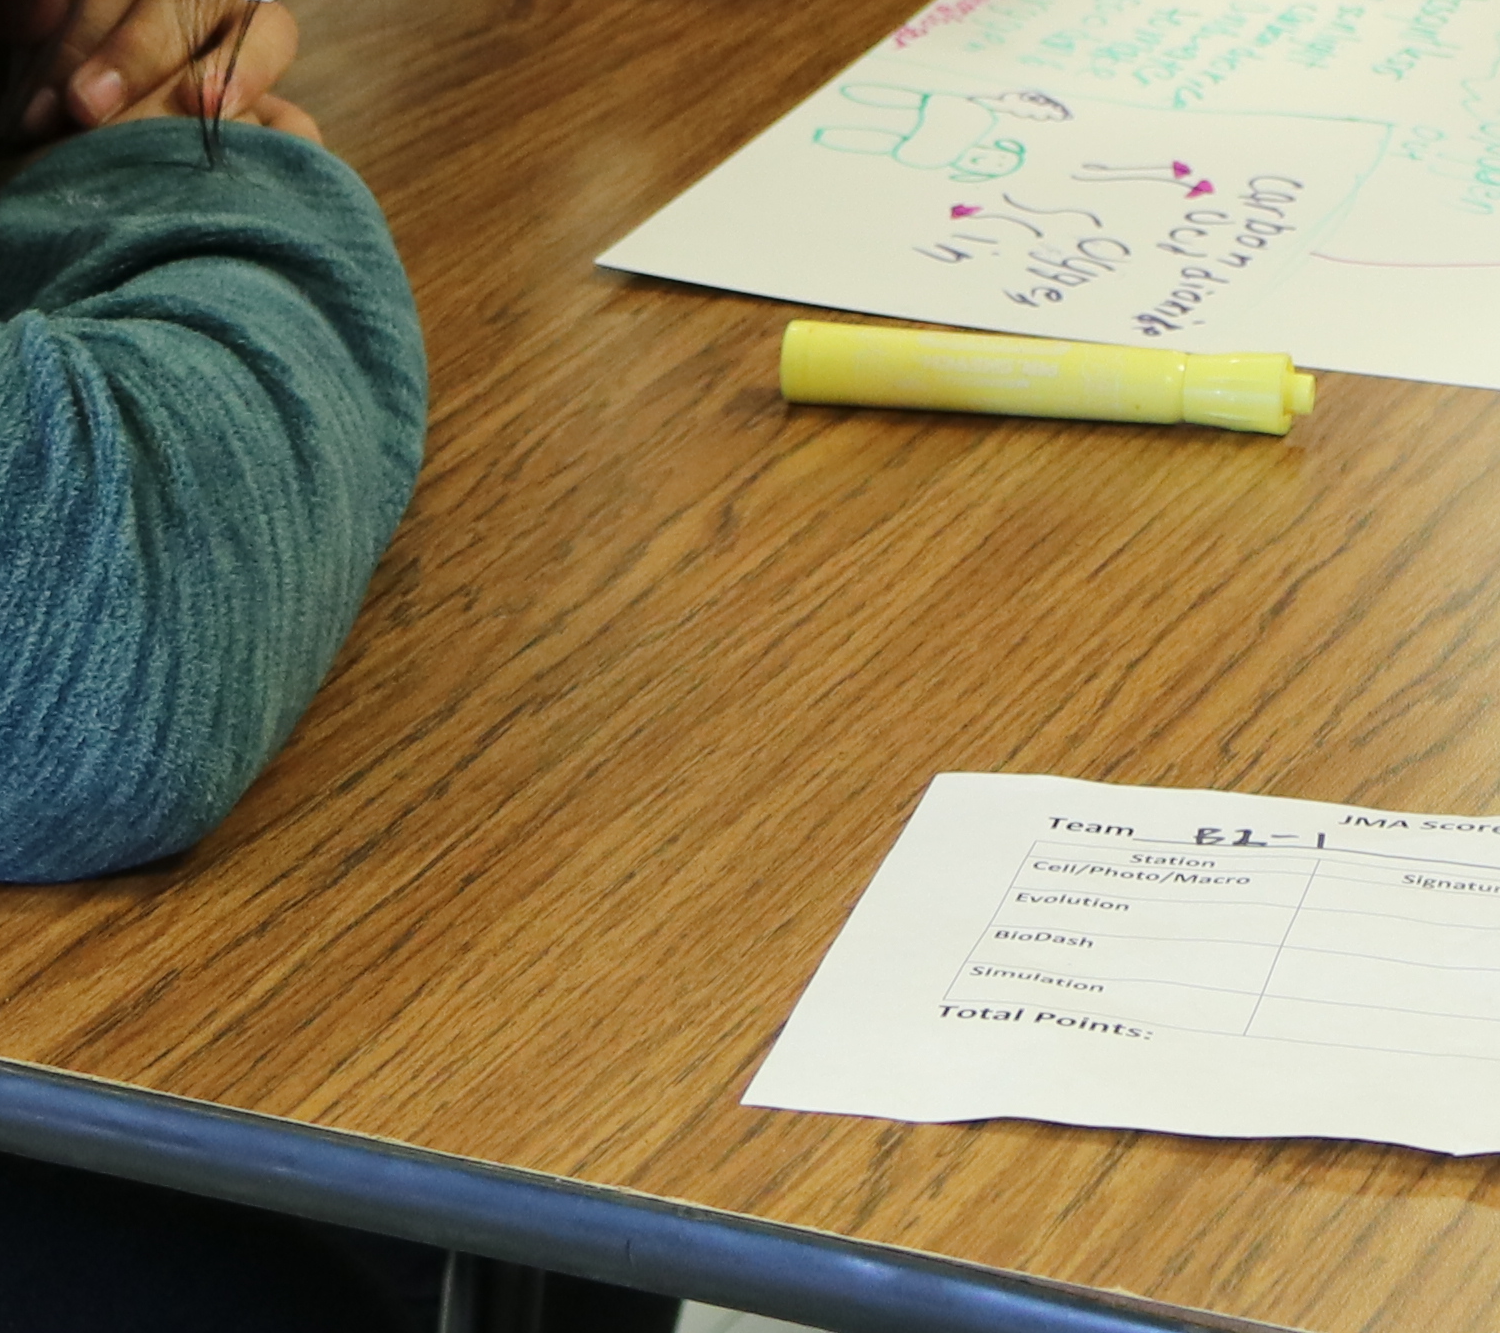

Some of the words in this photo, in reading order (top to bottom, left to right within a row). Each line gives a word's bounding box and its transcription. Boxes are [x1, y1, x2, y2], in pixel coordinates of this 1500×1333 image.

[1048, 816, 1134, 838] Team
[1338, 814, 1409, 830] JMA
[1130, 853, 1216, 868] Station
[1032, 860, 1251, 886] Cell/Photo/Macro
[1015, 892, 1130, 913] Evolution
[993, 930, 1094, 950] BioDash
[968, 965, 1105, 994] Simulation
[938, 1004, 1025, 1022] Total
[1033, 1011, 1154, 1041] Points:
